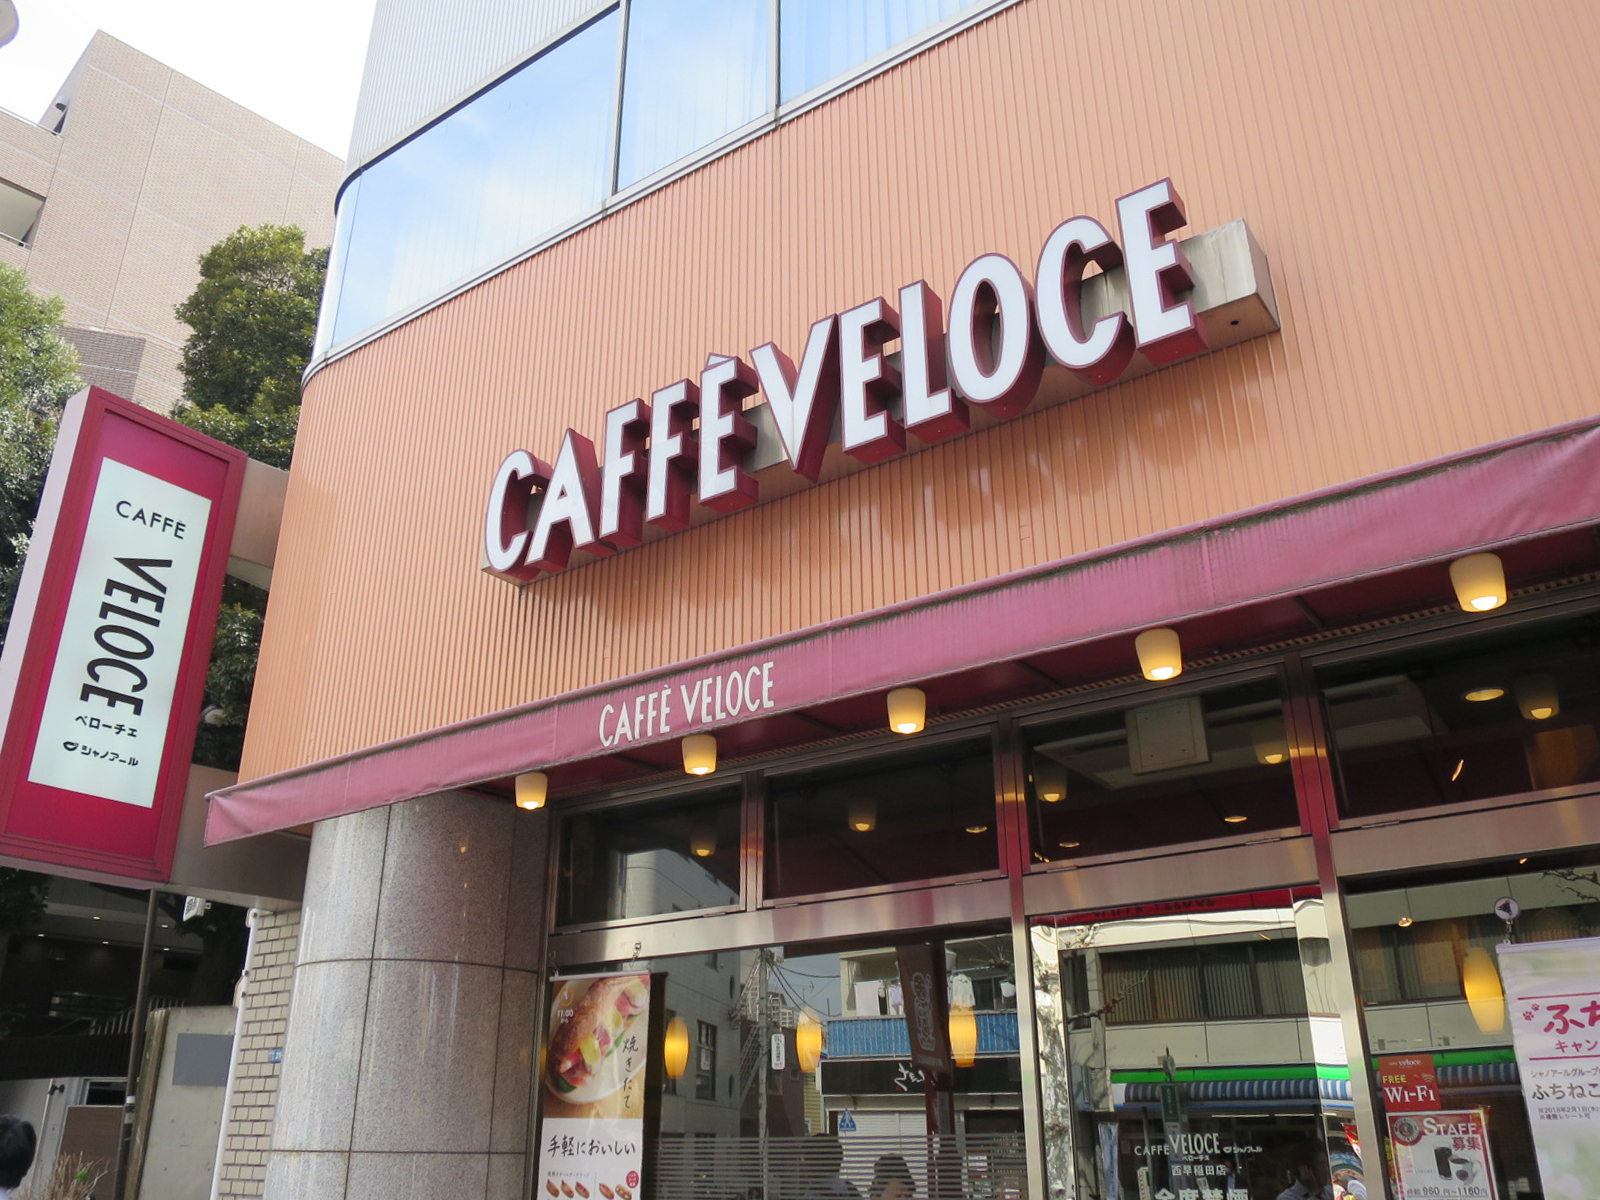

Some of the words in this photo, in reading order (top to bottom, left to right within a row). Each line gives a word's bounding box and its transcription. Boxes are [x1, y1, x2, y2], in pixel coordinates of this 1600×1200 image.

[749, 177, 1200, 477] VELOCE
[80, 557, 173, 716] VELOCE
[599, 684, 672, 747] CAFFÈ
[680, 661, 775, 724] VELOCE
[75, 714, 138, 738] ベローチェ
[81, 744, 139, 767] シャノアール
[622, 1035, 639, 1109] 焼きたて
[1382, 1074, 1407, 1084] FREE
[1530, 1066, 1600, 1079] シャノアールグループ
[547, 1134, 636, 1158] 手軽においしい
[1168, 1133, 1220, 1155] VELOCE
[1451, 1136, 1481, 1151] 募集
